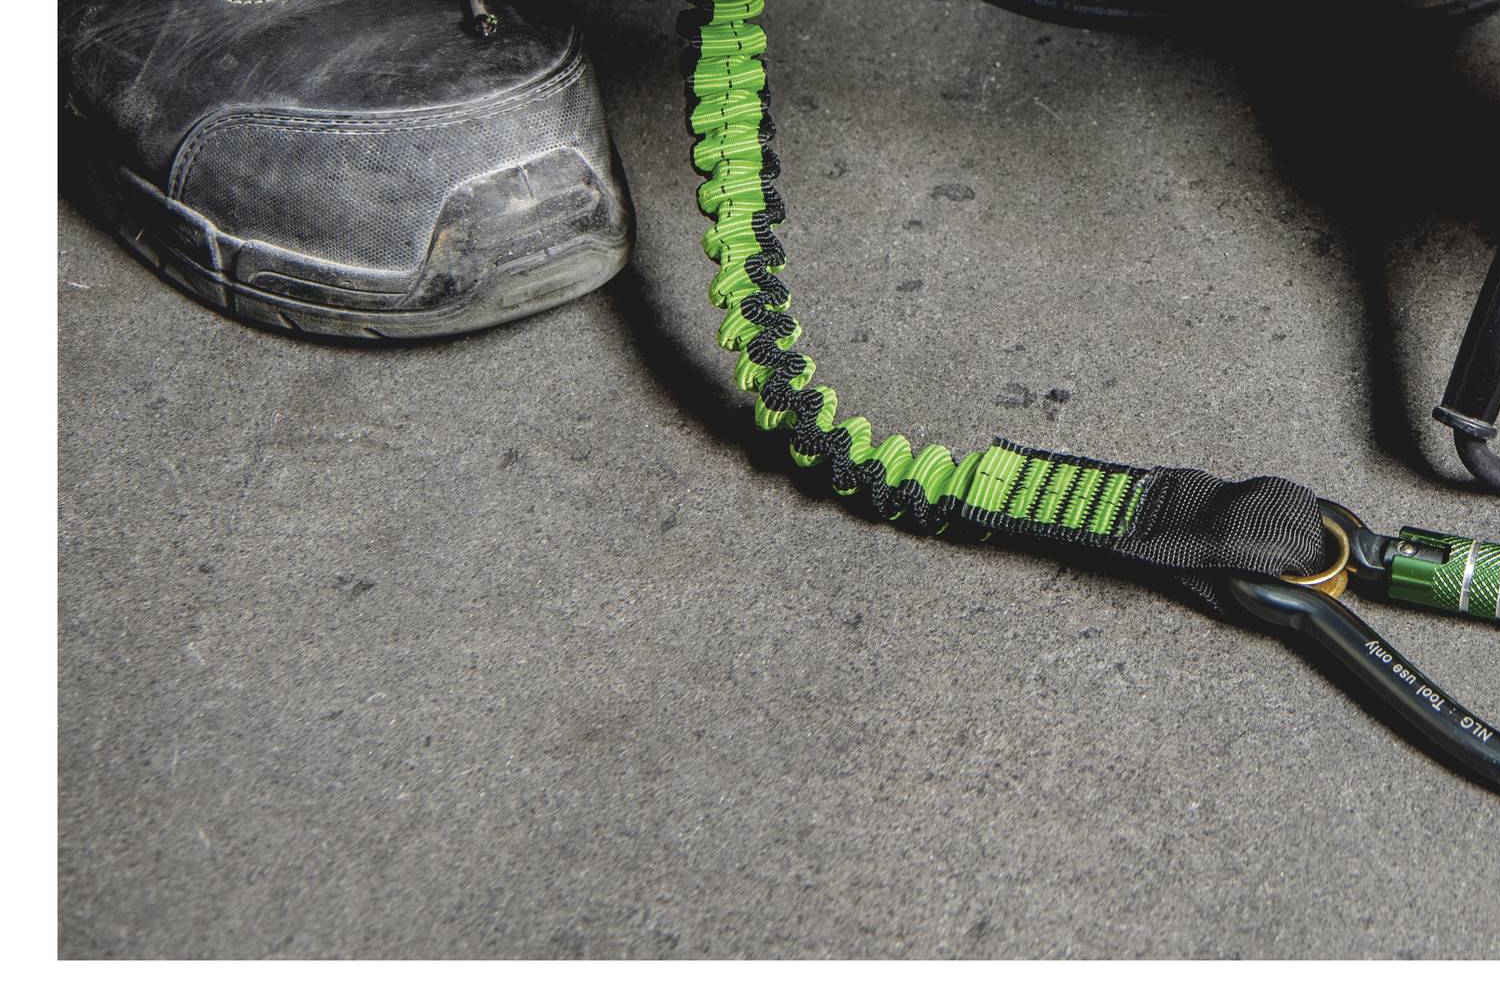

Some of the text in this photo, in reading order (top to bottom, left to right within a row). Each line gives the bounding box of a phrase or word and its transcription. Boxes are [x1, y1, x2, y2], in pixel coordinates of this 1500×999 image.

[1365, 640, 1392, 663] only
[1392, 663, 1416, 684] use
[1416, 685, 1445, 712] Tool
[1459, 715, 1493, 742] NLG
